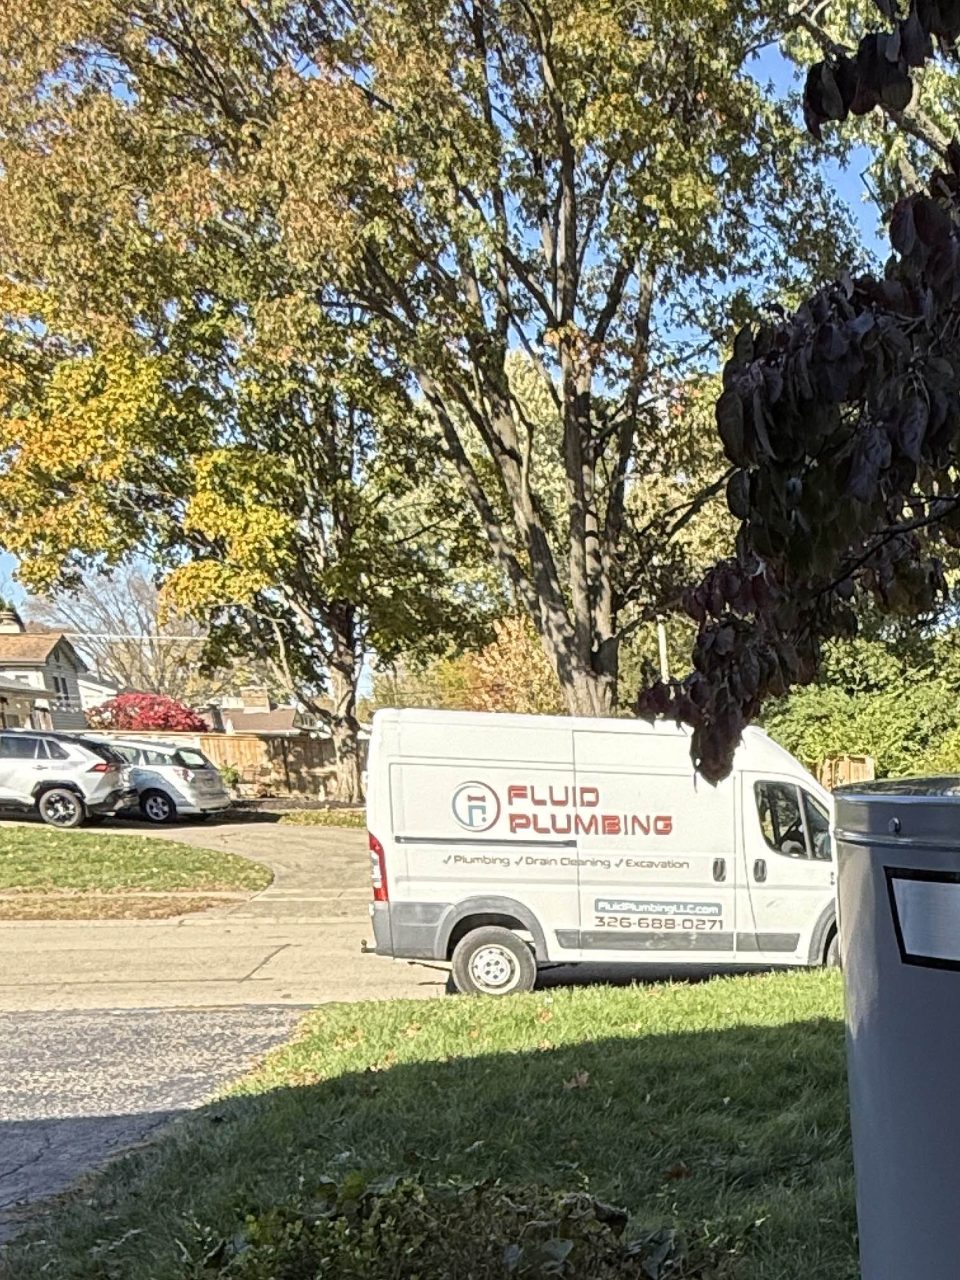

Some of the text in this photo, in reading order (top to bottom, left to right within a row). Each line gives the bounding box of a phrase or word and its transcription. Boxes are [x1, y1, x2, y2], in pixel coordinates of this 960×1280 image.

[507, 785, 600, 808] FLUID
[509, 813, 673, 836] PLUMBING
[453, 855, 690, 869] Plumbing Drain Cleaning Excavation
[595, 916, 724, 930] 326-688-0271
